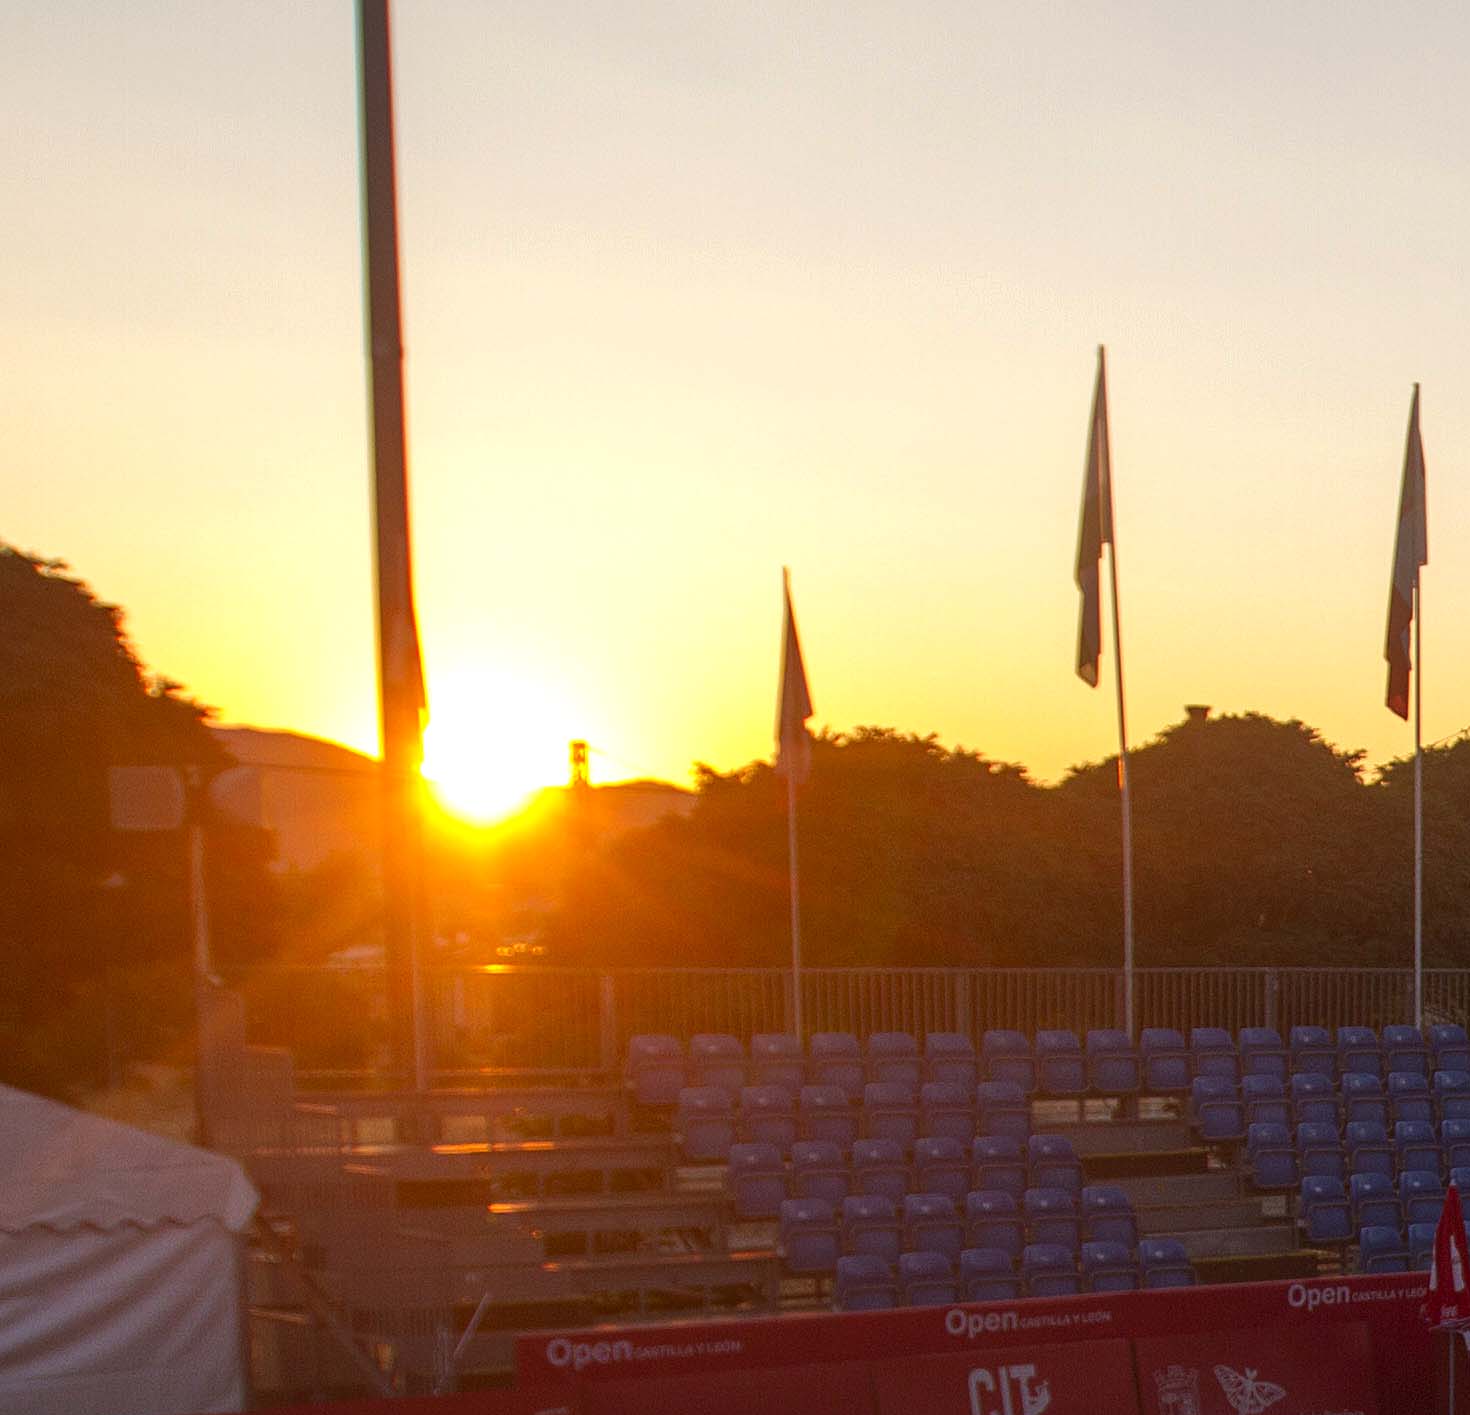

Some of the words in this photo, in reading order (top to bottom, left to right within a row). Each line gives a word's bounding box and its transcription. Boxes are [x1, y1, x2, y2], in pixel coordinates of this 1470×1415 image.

[1287, 1283, 1350, 1311] Open
[1351, 1289, 1396, 1303] CASTILLA
[945, 1309, 1018, 1339] Open
[1019, 1313, 1070, 1329] CASTILLA
[1071, 1312, 1081, 1323] Y
[546, 1338, 632, 1371] Open
[634, 1342, 693, 1360] CASTILLA
